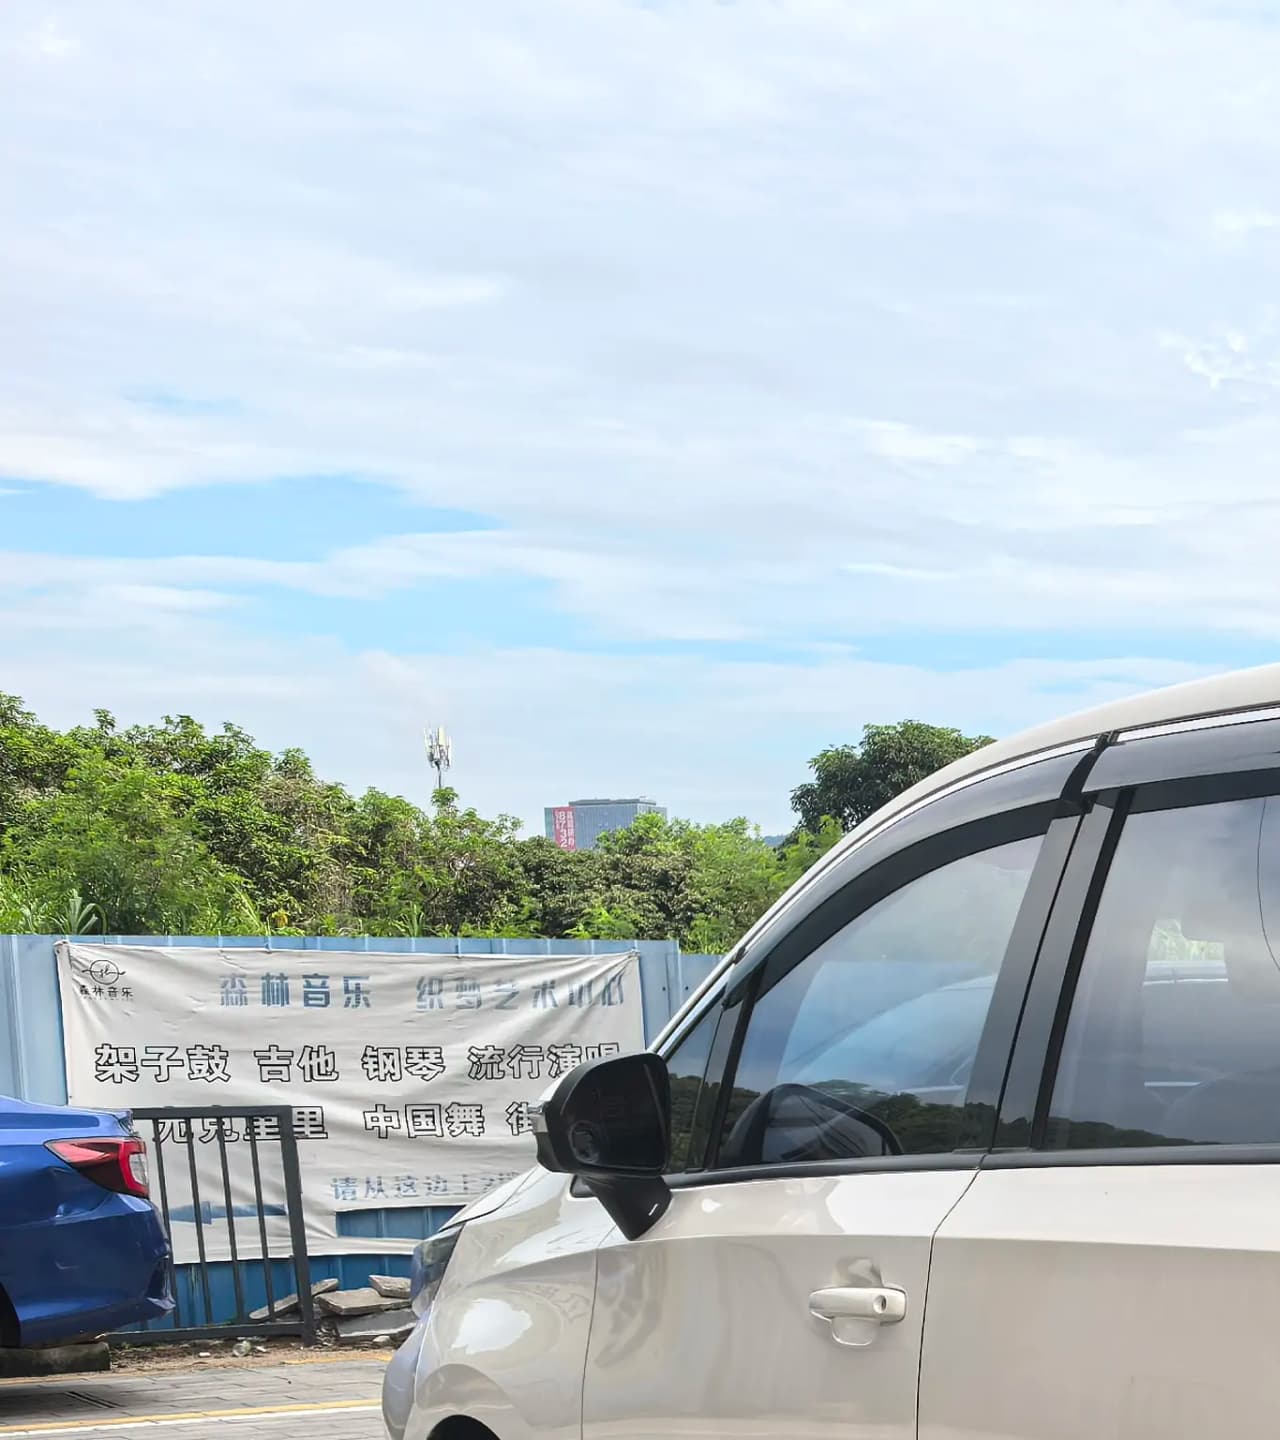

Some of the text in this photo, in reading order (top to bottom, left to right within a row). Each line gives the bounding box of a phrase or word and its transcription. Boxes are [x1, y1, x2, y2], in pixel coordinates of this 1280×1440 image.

[218, 972, 372, 1009] 森林音乐
[94, 1043, 232, 1083] 架子鼓
[253, 1044, 340, 1083] 吉他
[361, 1045, 447, 1082] 钢琴
[362, 1101, 486, 1140] 中国舞
